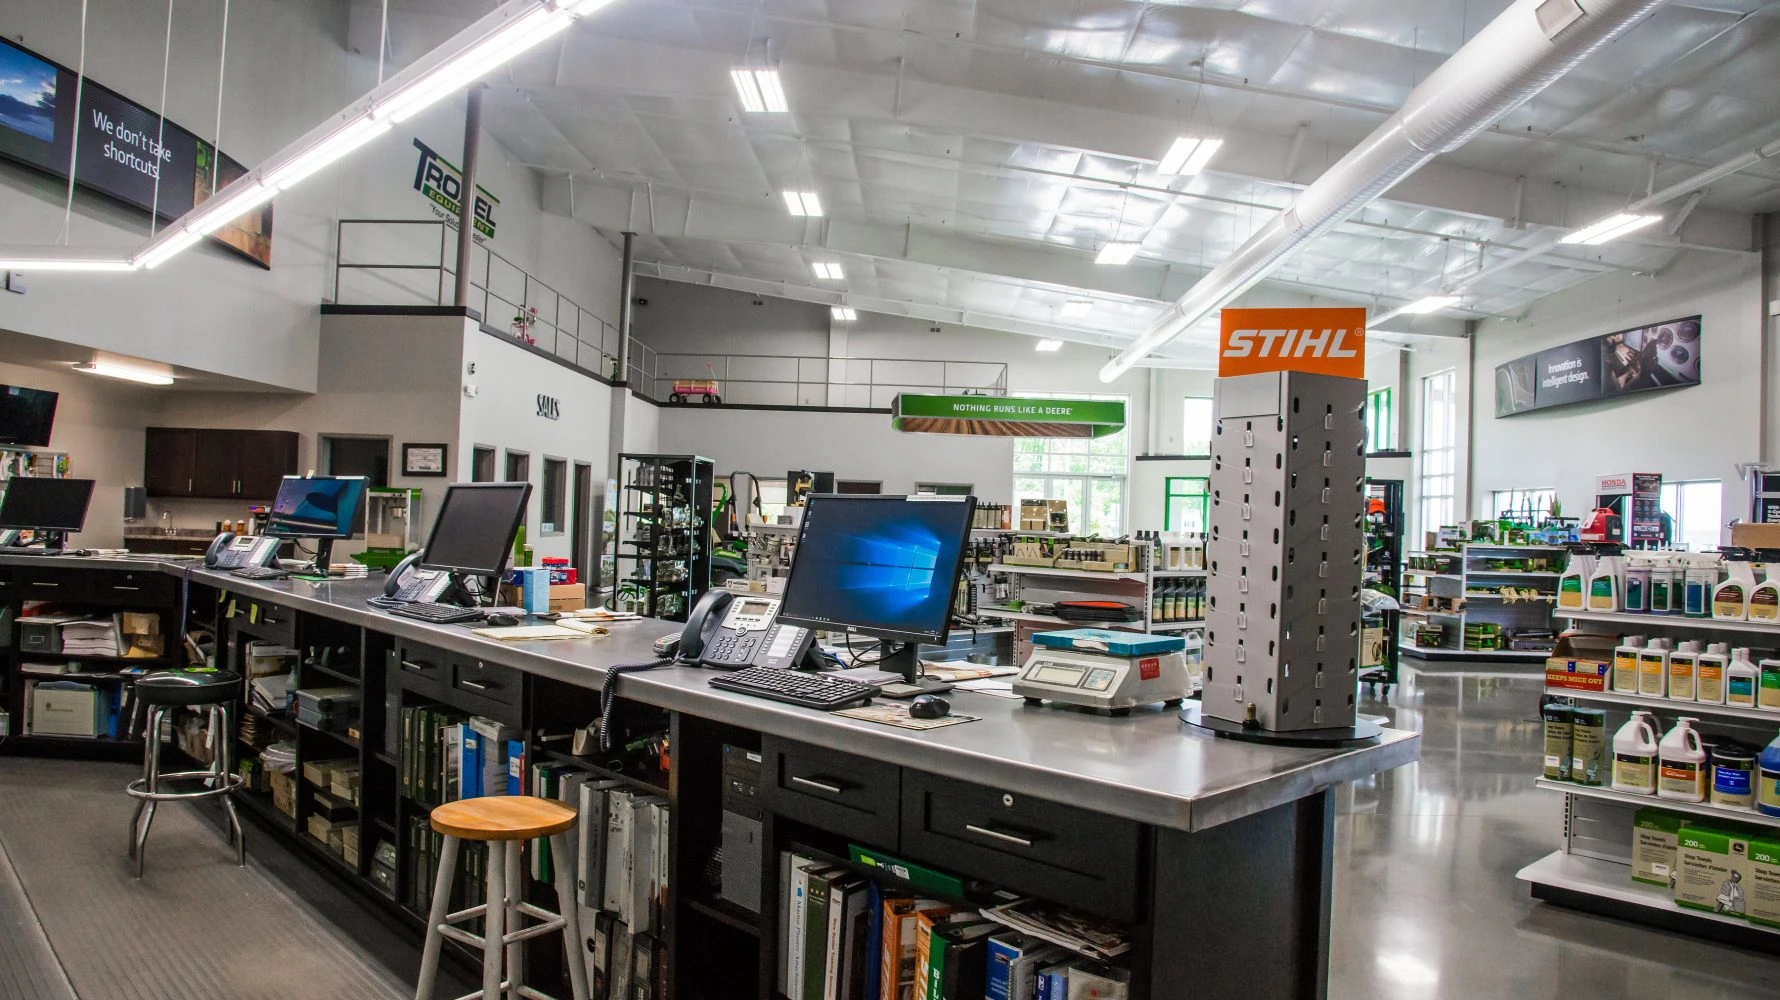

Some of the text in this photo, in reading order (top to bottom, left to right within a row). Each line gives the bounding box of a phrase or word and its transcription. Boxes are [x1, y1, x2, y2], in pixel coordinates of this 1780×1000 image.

[93, 108, 172, 162] We don’t take
[103, 140, 160, 180] shortcuts.
[413, 137, 497, 228] TROEL
[429, 189, 490, 234] EQUIPENT
[1548, 359, 1576, 374] Innovation
[1542, 374, 1568, 389] intelligent
[953, 403, 991, 412] NOTHING
[993, 405, 1016, 413] RUNS
[1018, 406, 1036, 414] LIKE
[1037, 406, 1043, 414] A
[1601, 479, 1626, 487] HONDA
[1684, 839, 1699, 848] 200
[1755, 853, 1770, 862] 200
